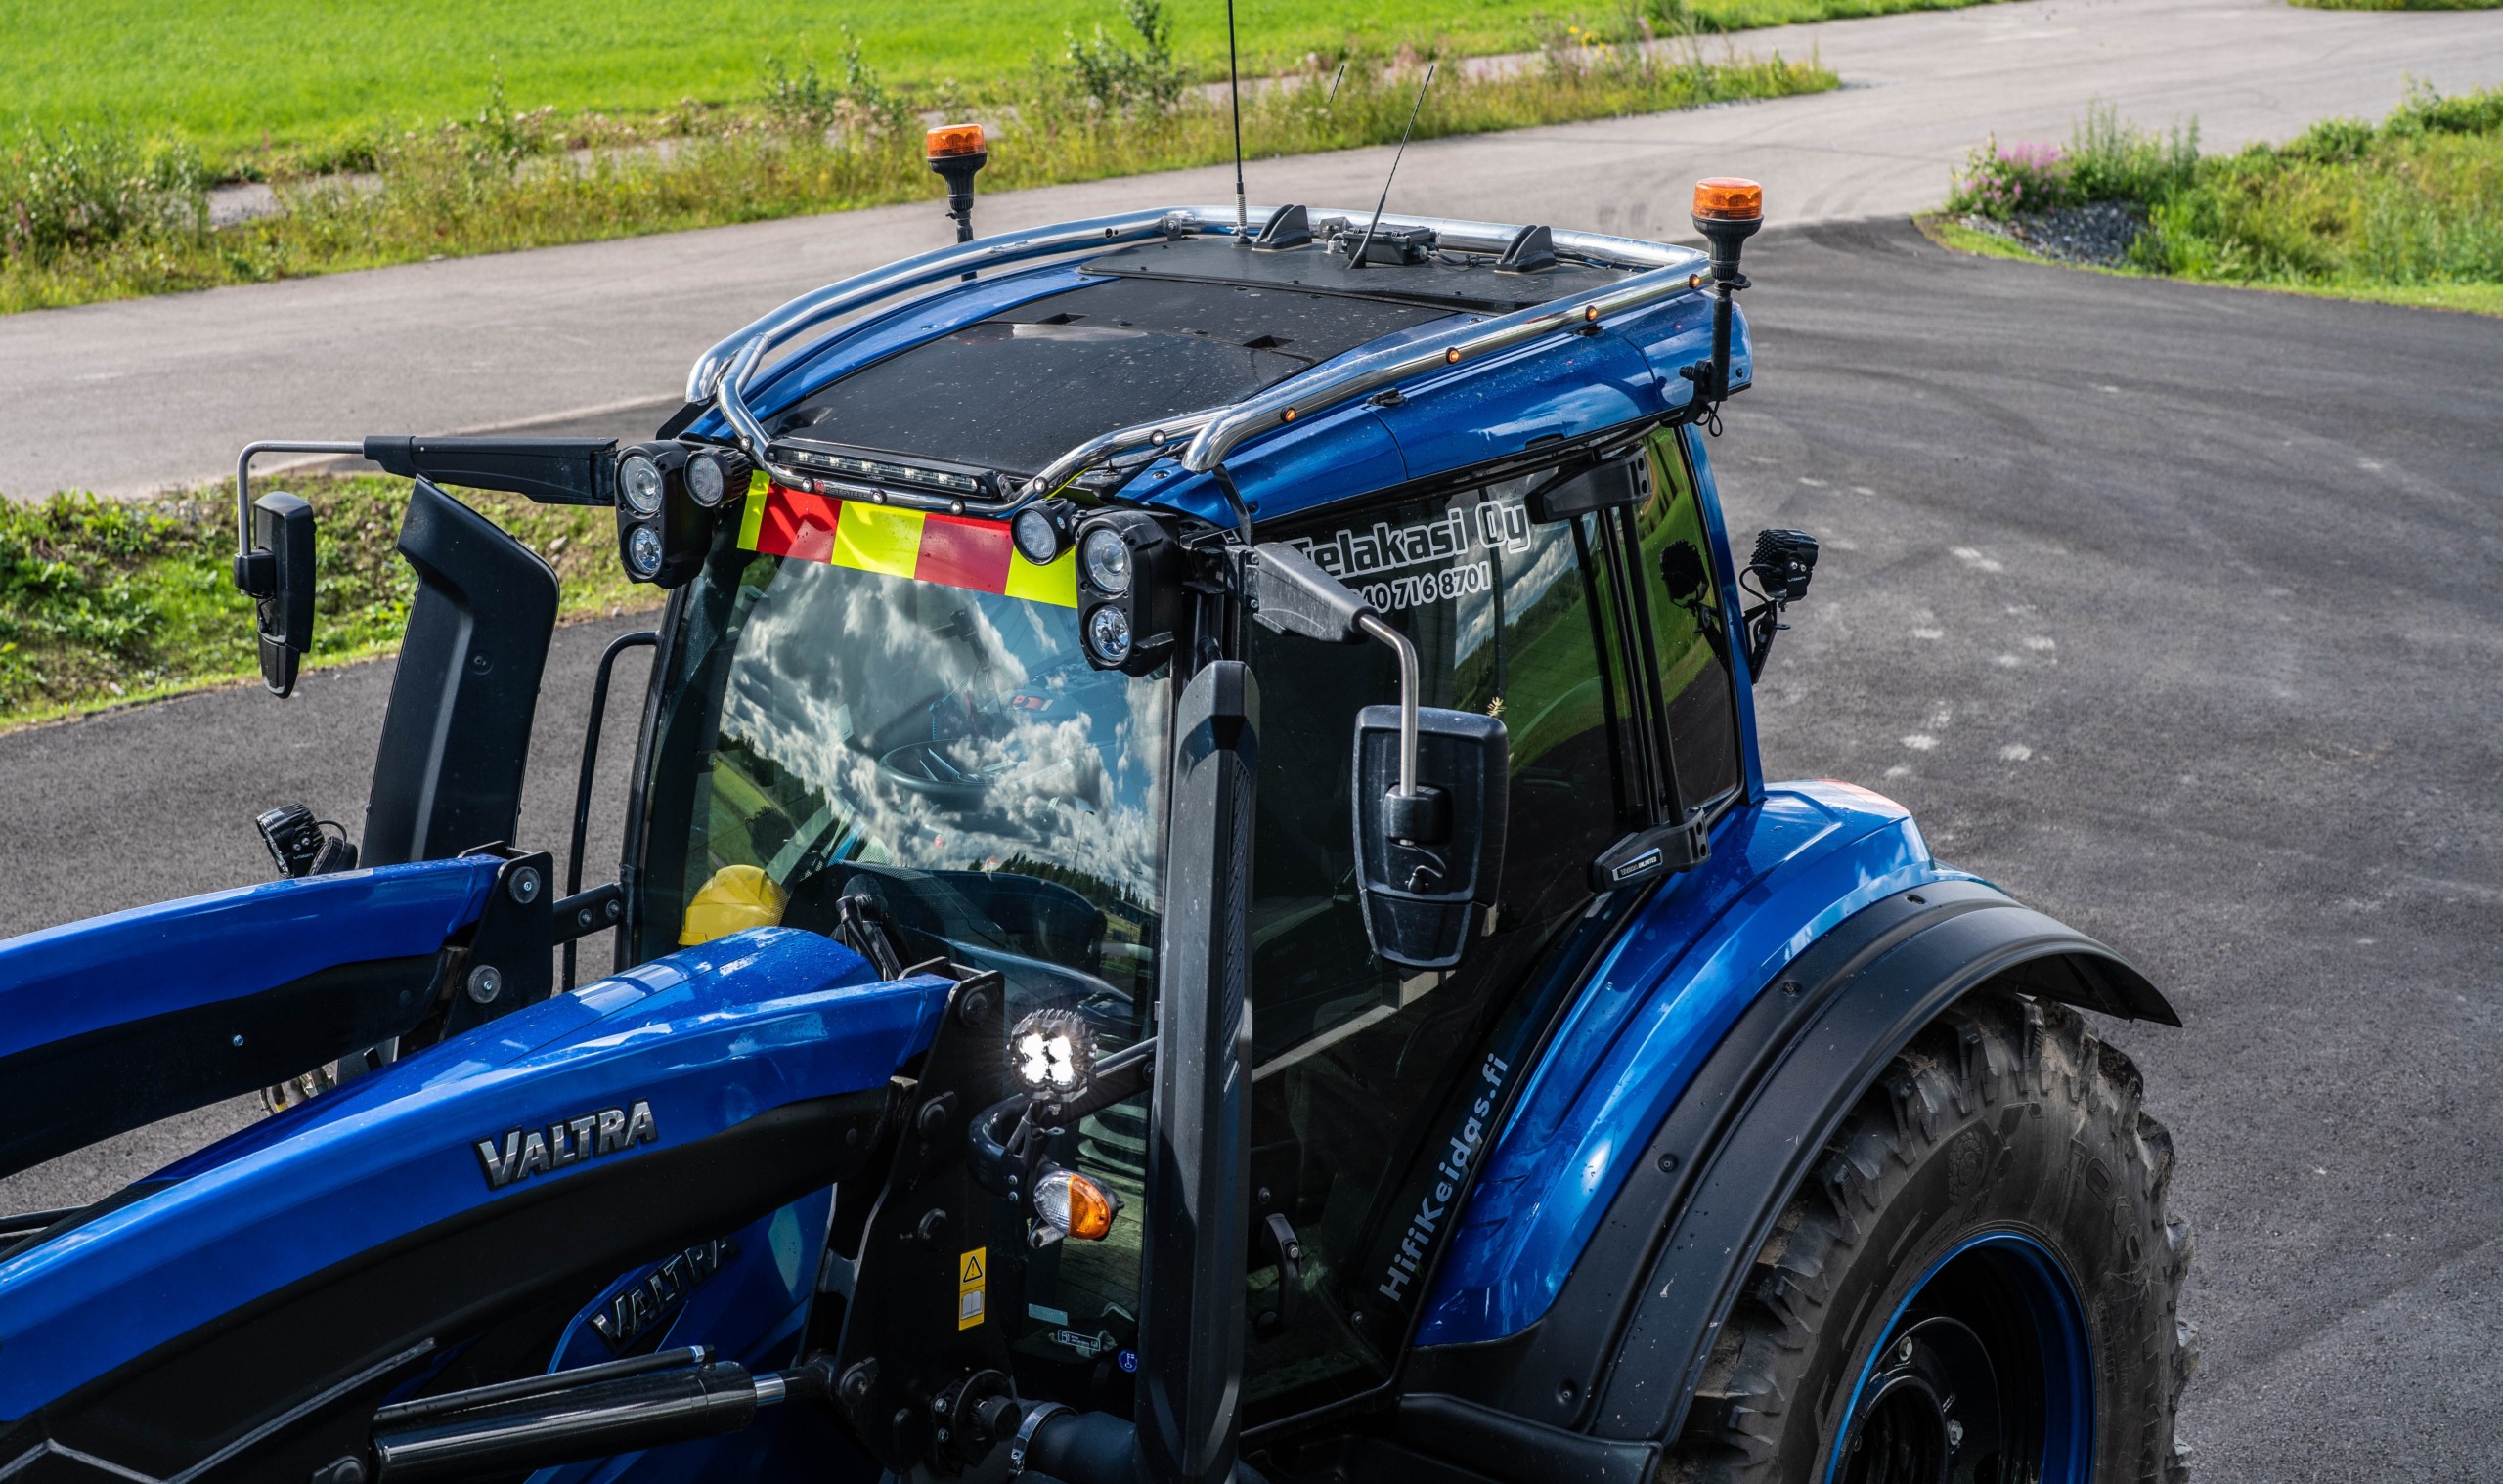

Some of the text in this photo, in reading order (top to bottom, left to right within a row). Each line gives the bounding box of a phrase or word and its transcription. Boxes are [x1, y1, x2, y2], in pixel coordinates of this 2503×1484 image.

[1475, 501, 1531, 552] Oy
[1349, 561, 1491, 613] 40 716 8701
[475, 1099, 658, 1189] VALTRA
[1379, 1053, 1508, 1301] HifiKeidas.fi
